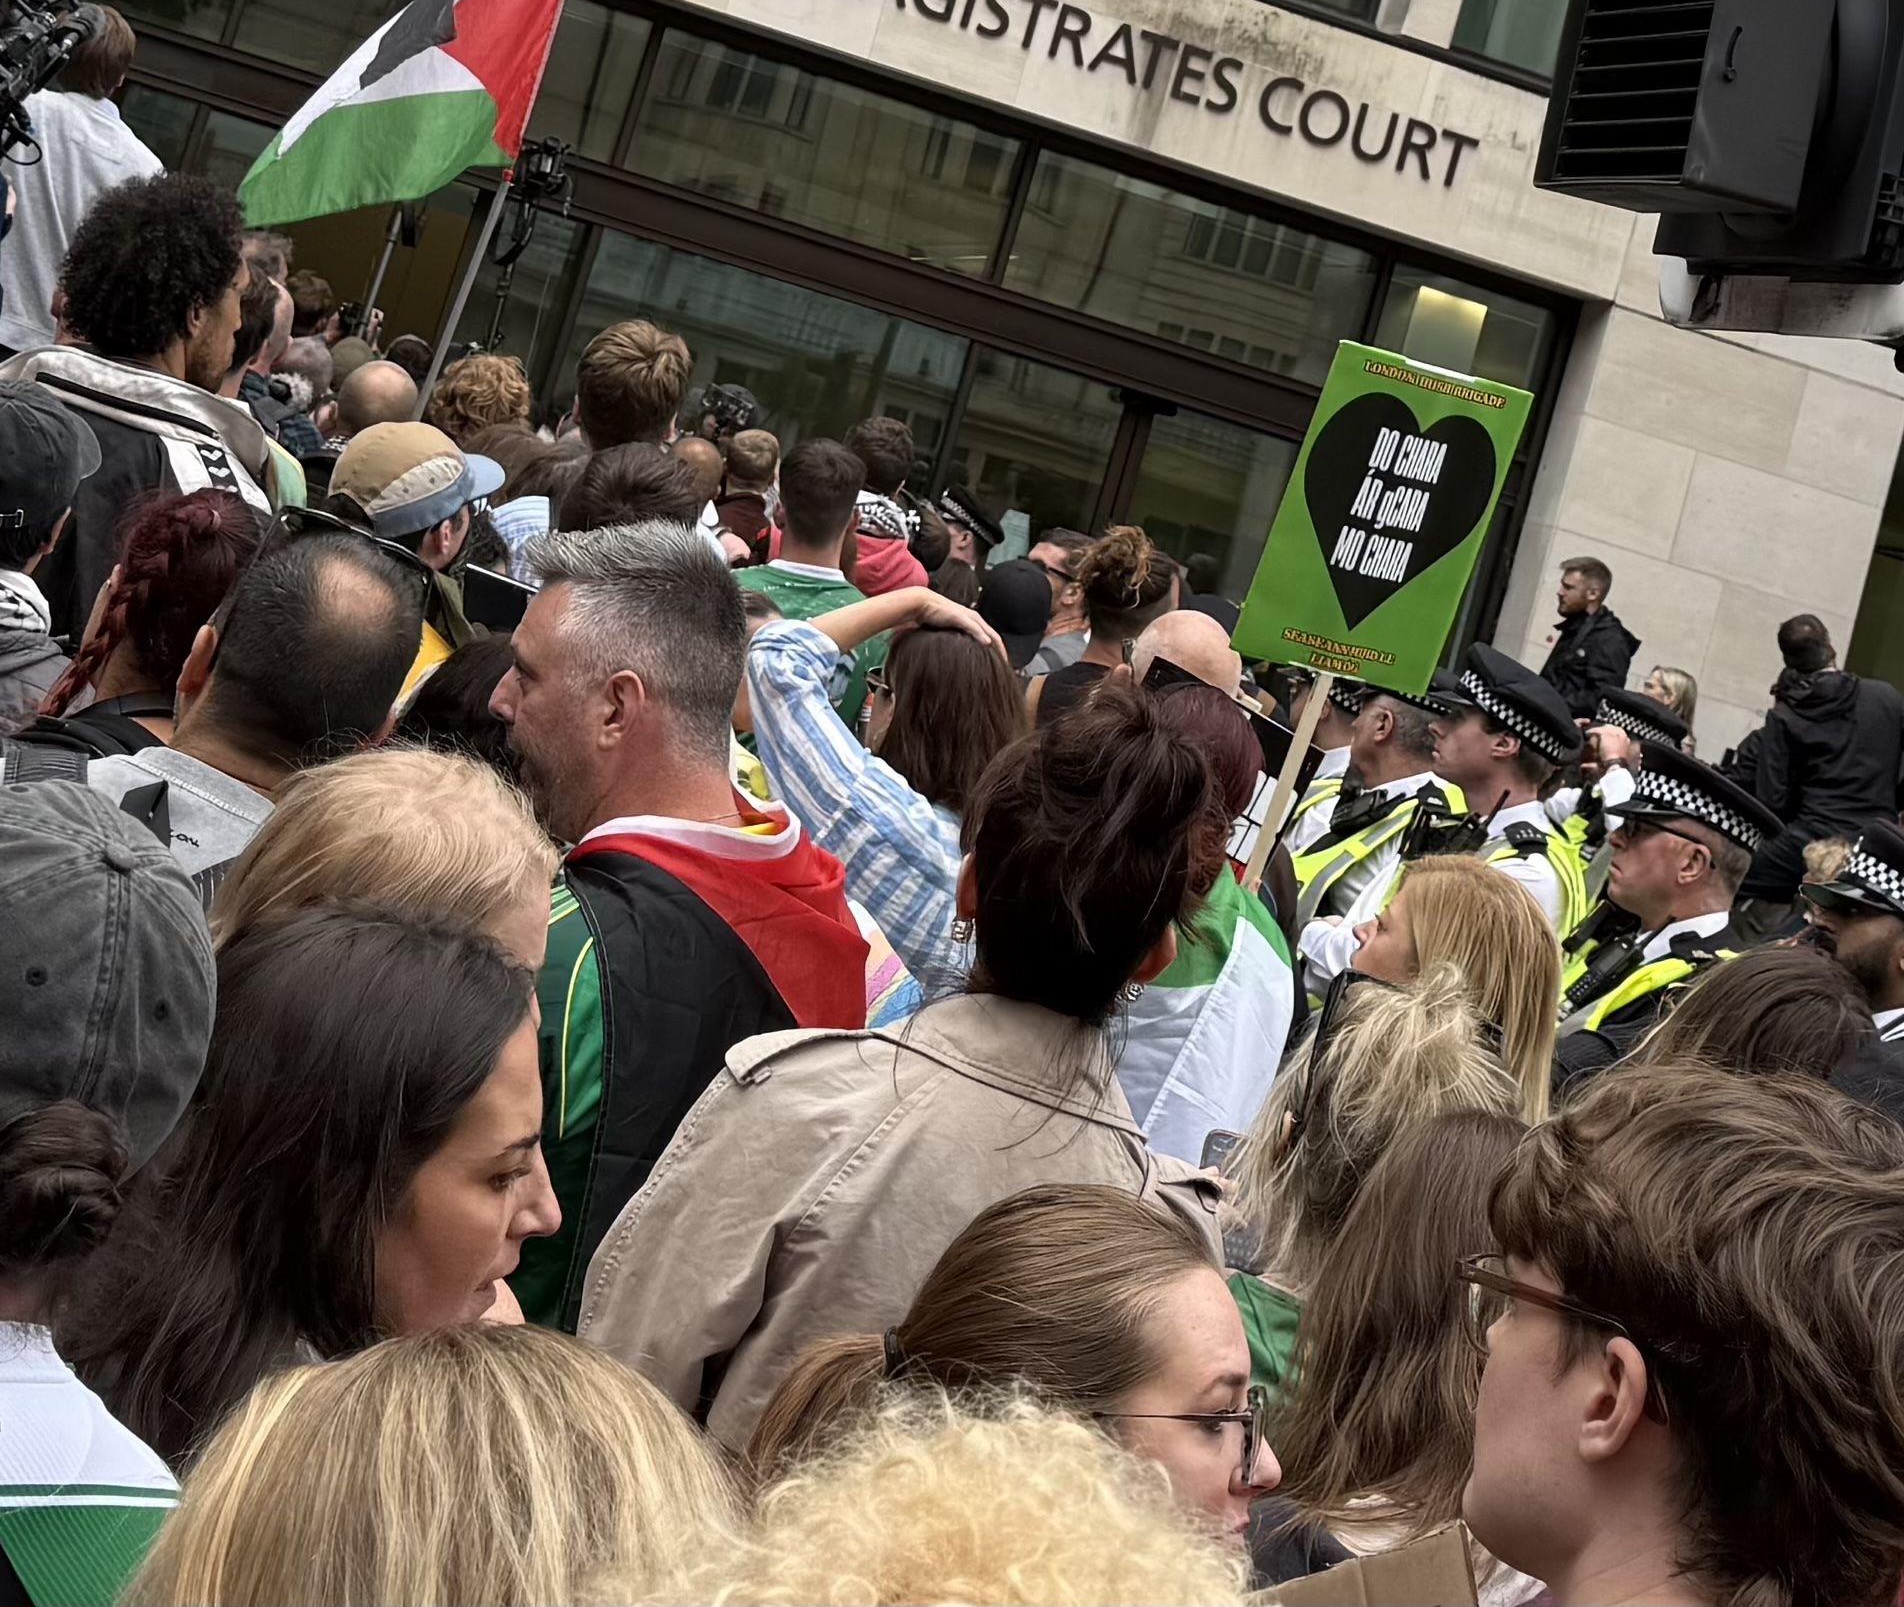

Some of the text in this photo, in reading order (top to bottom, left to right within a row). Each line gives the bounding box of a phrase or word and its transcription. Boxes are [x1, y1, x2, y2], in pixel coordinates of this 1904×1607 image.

[1258, 76, 1480, 189] COURT
[1368, 426, 1448, 484] DO CHARA
[1350, 468, 1430, 533] ÁR gCARA
[1330, 525, 1414, 583] MO CHARA
